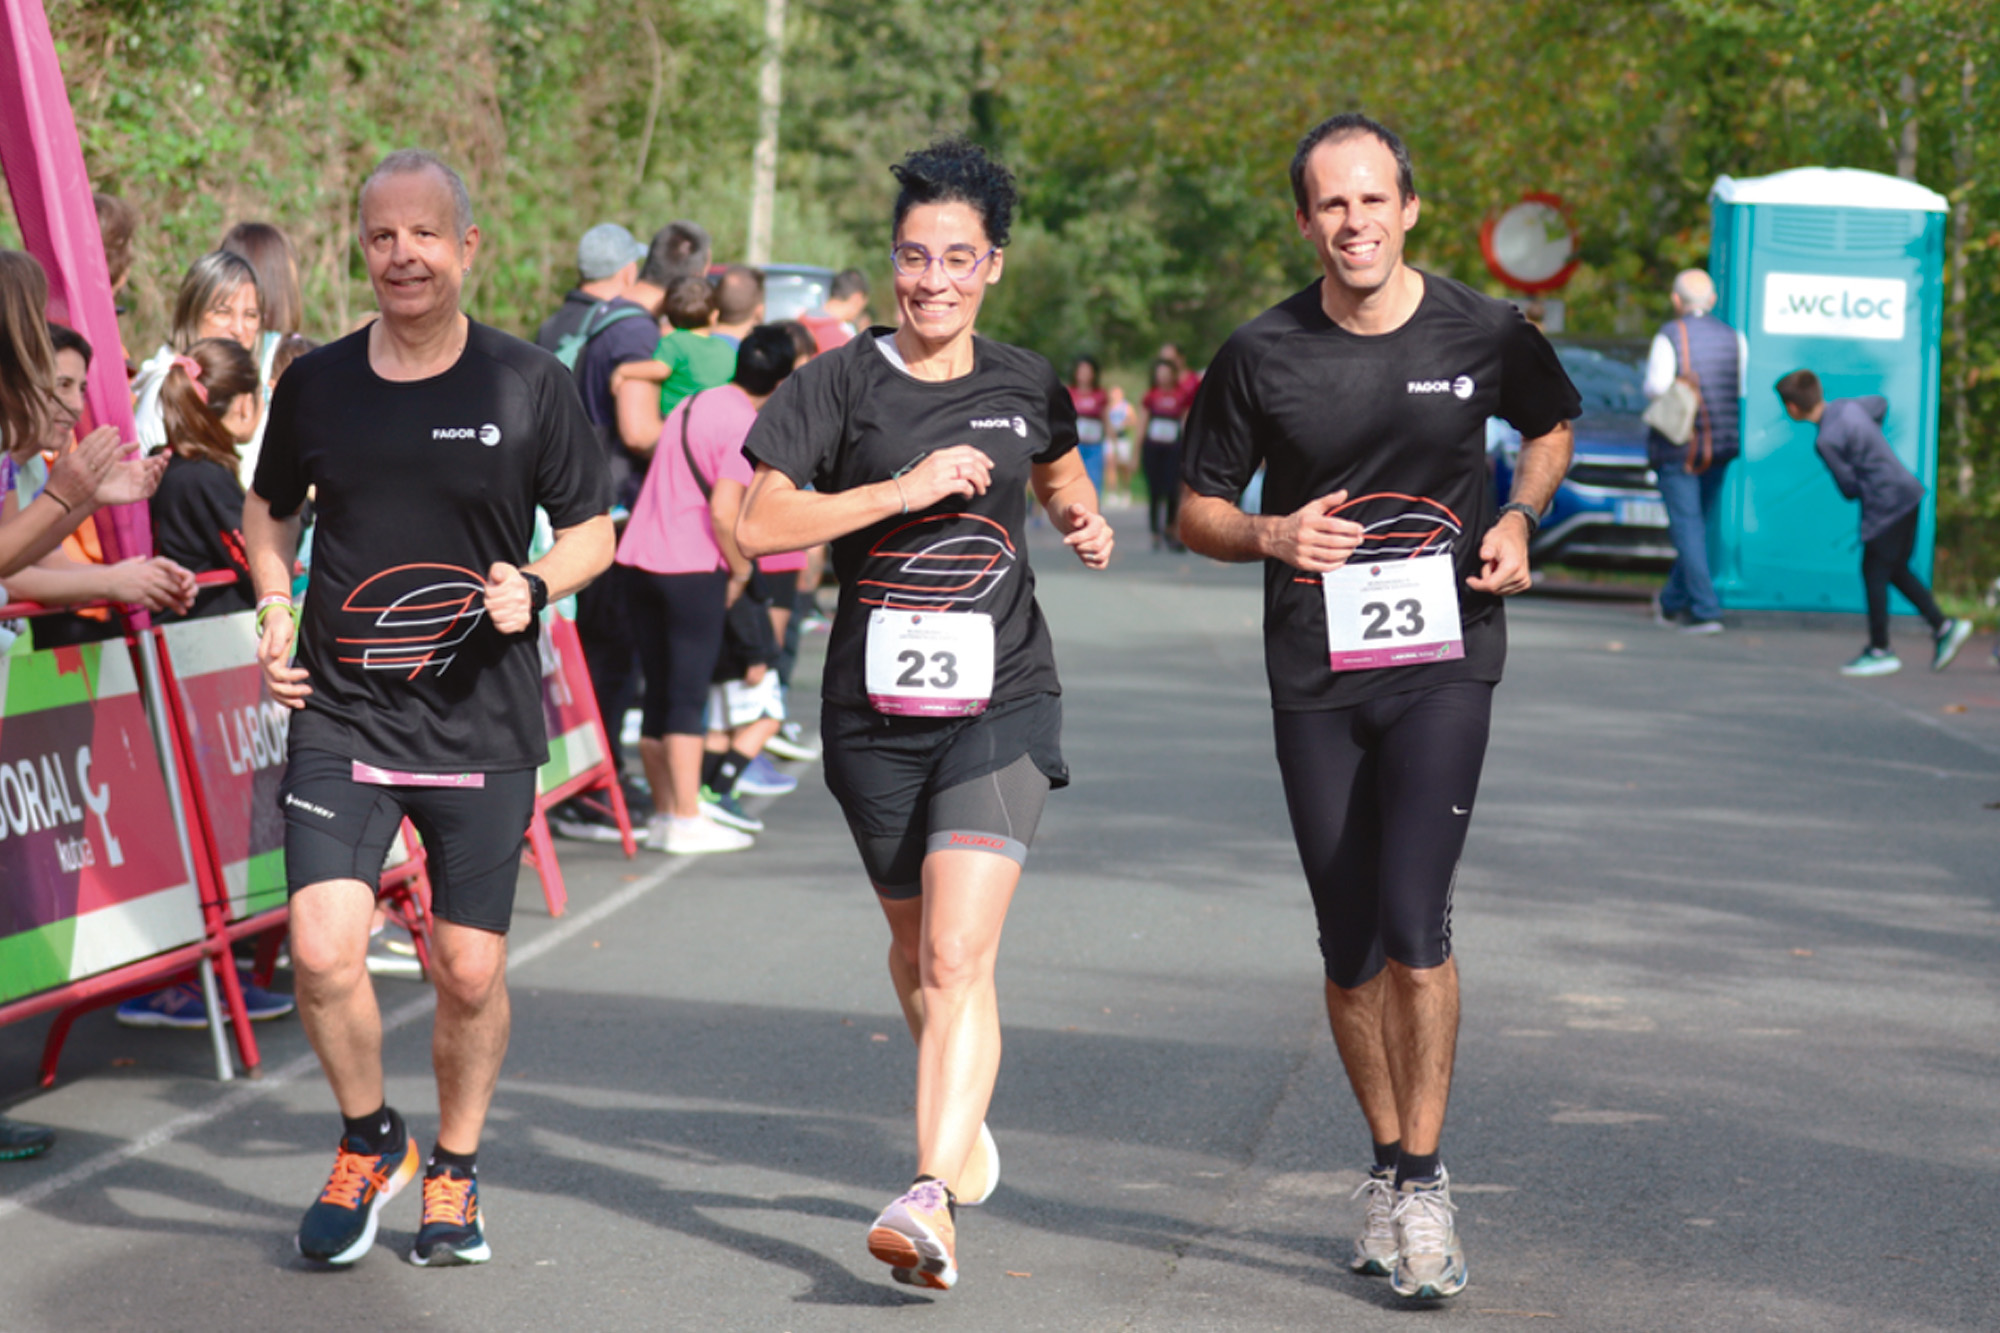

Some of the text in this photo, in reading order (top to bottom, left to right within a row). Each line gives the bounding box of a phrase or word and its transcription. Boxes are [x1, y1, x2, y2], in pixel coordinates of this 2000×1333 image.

[1407, 381, 1450, 393] FAGOR
[432, 428, 476, 440] FAGOR
[970, 418, 1011, 429] FAGOR
[1362, 599, 1425, 640] 23
[896, 650, 959, 689] 23
[0, 752, 84, 841] ORAL
